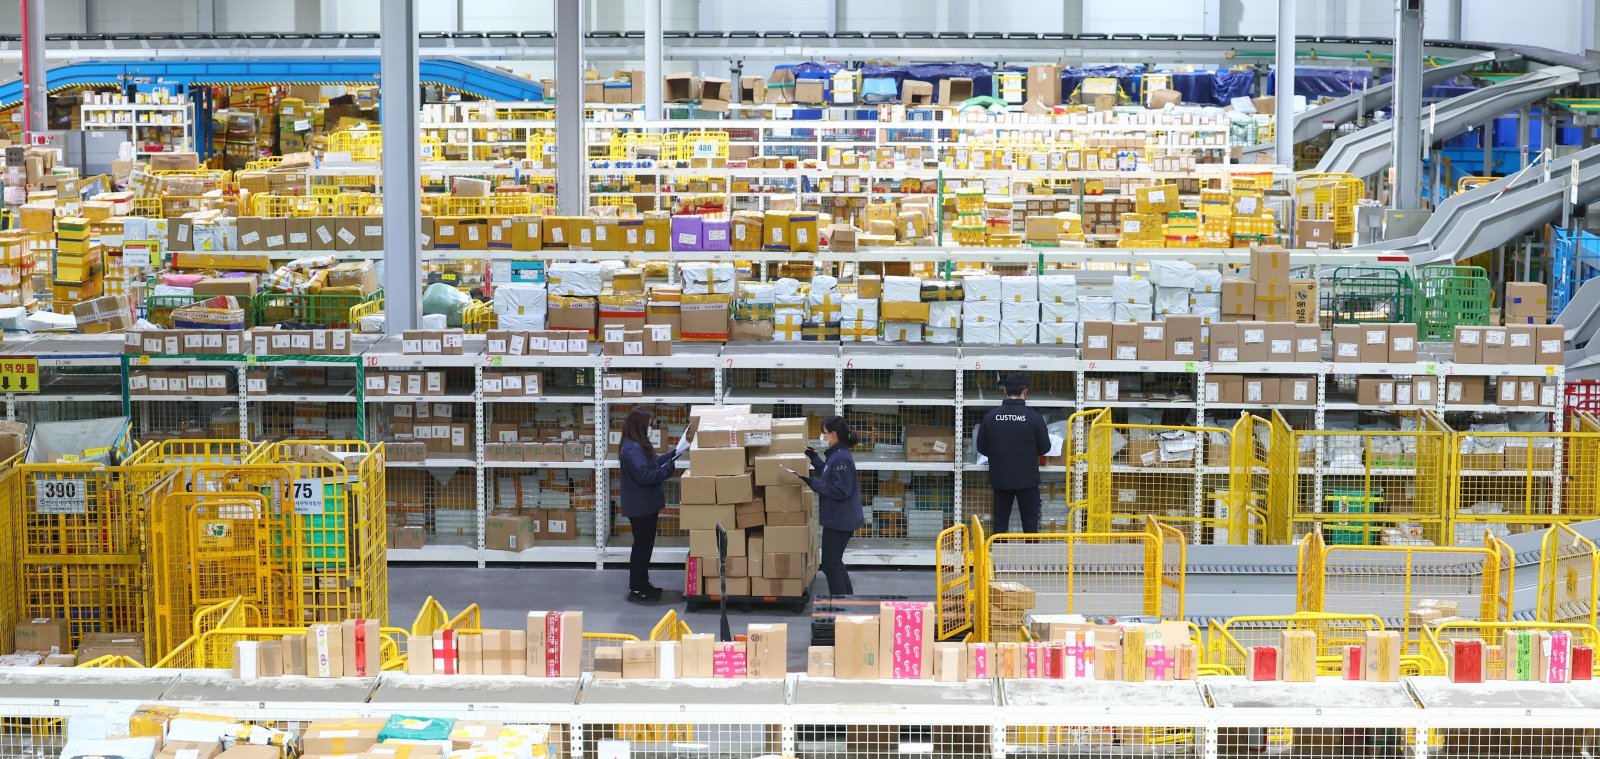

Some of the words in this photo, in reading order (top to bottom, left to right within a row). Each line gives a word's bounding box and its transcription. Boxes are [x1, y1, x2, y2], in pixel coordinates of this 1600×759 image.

[366, 356, 378, 366] 10
[486, 356, 493, 366] 9
[727, 359, 733, 368] 7
[846, 359, 854, 368] 6
[0, 364, 35, 374] 역화물
[1088, 362, 1096, 371] 4
[1208, 362, 1214, 372] 3
[1329, 364, 1334, 374] 2
[46, 482, 76, 498] 390
[284, 484, 312, 498] 775
